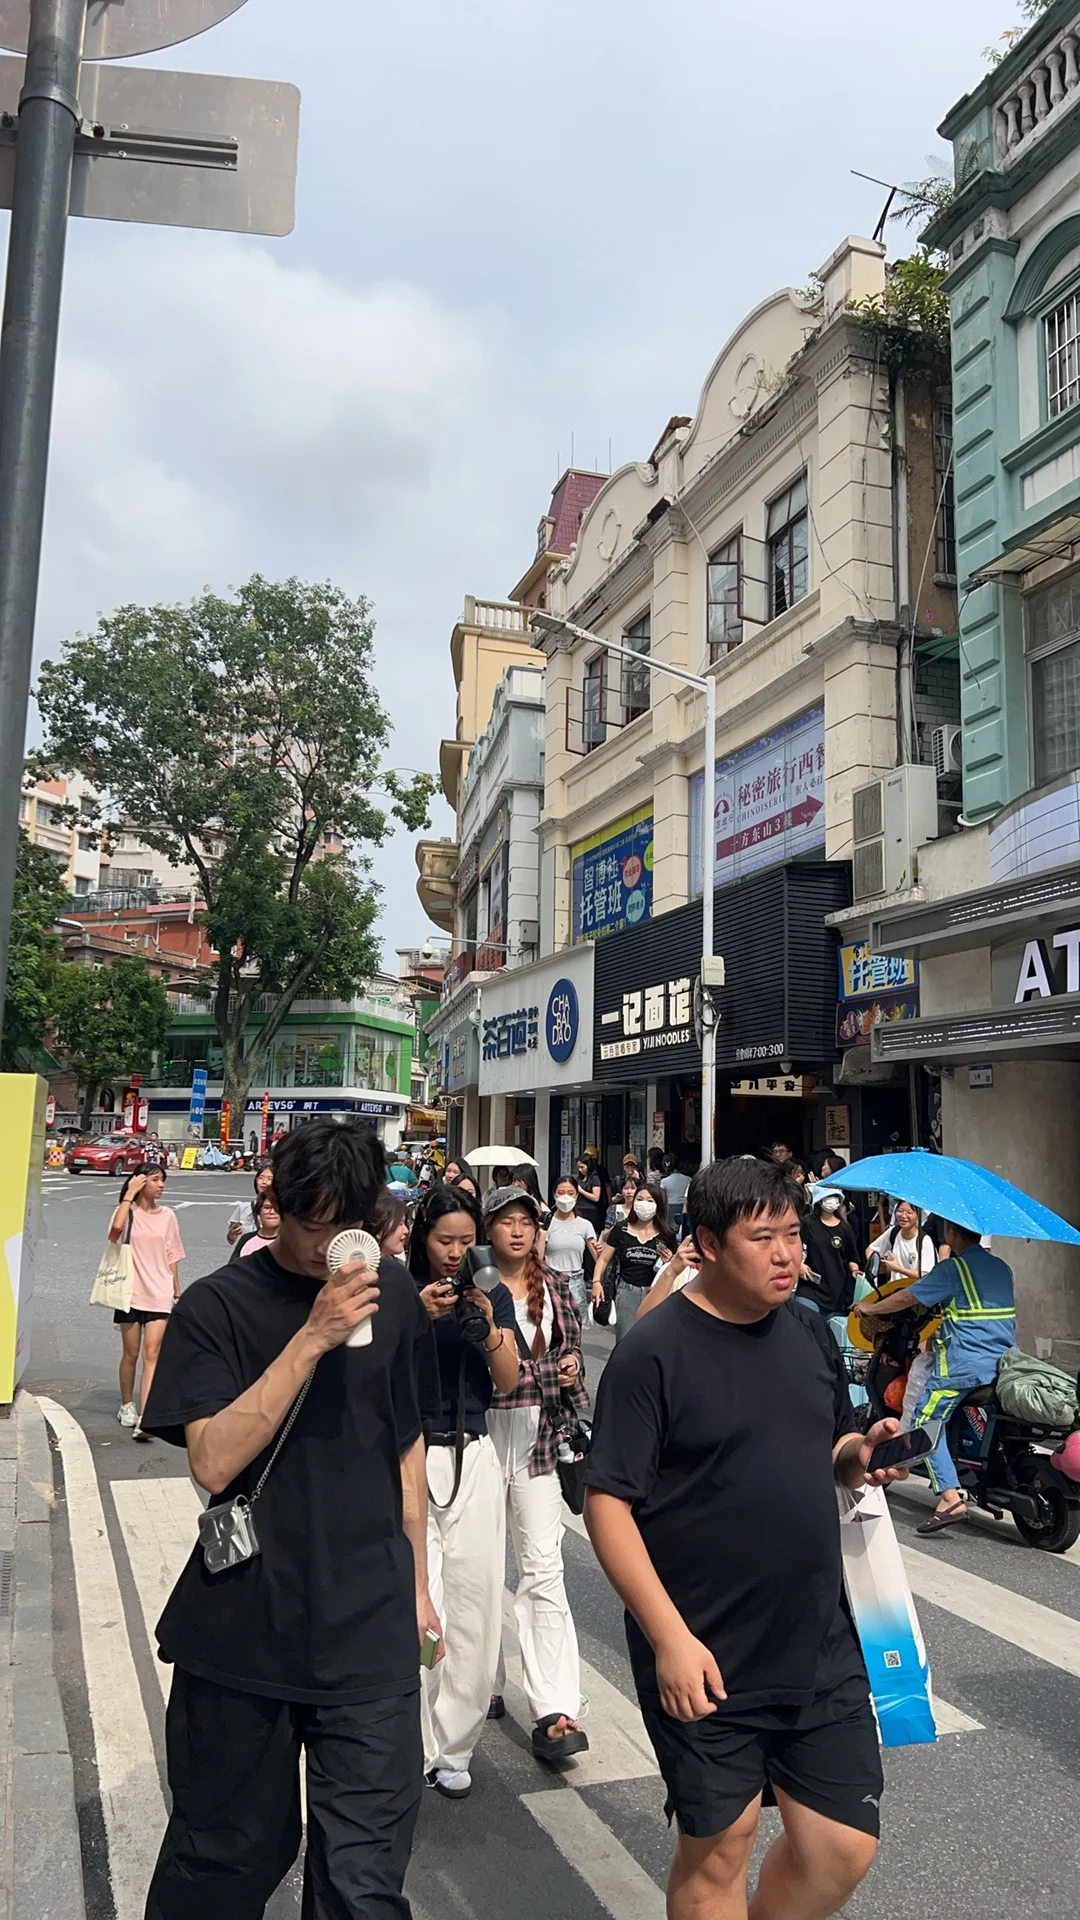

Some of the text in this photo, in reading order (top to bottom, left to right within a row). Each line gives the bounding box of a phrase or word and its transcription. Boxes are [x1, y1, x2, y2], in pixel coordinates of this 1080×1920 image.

[584, 853, 619, 892] 智博社
[580, 880, 622, 929] 托管班
[552, 993, 571, 1017] CHA
[557, 1009, 570, 1027] BAI
[601, 978, 690, 1035] 一记面馆
[483, 1008, 527, 1060] 茶百道
[552, 1024, 572, 1046] DAO
